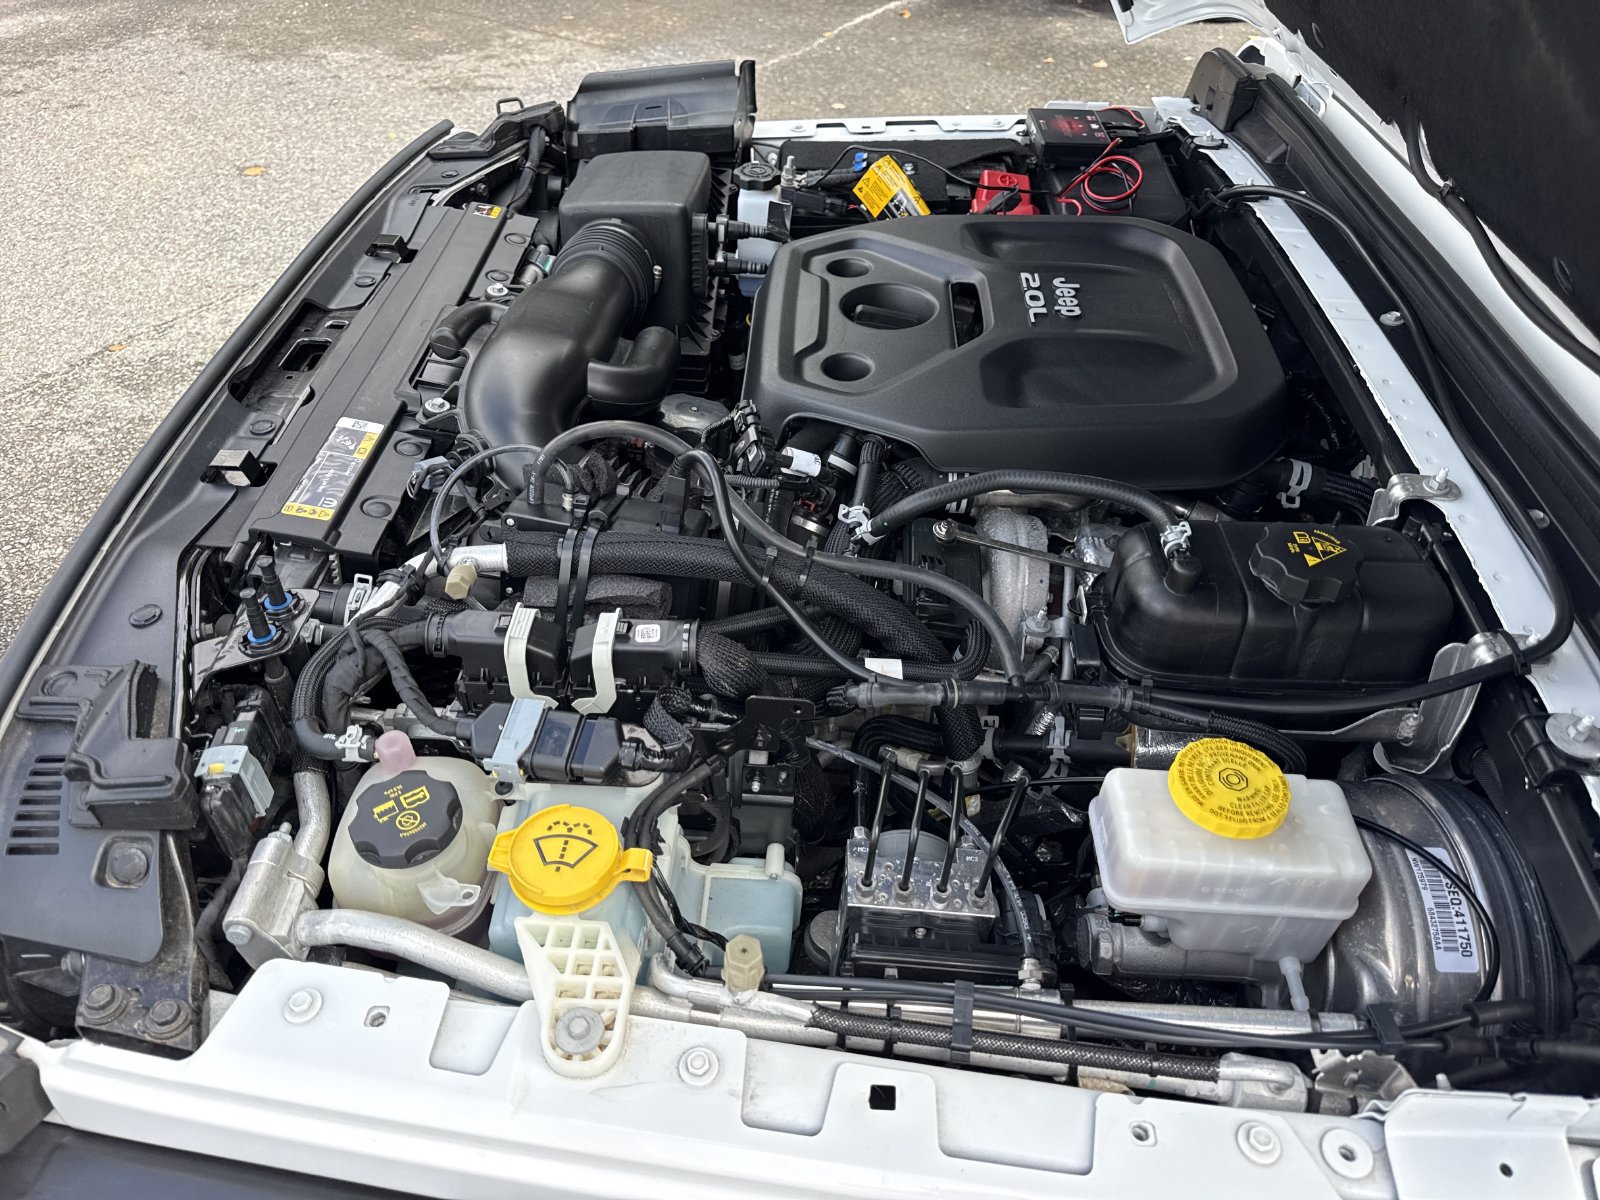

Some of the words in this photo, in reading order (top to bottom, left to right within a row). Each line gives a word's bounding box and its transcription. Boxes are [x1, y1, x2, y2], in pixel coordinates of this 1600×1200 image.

[1020, 272, 1048, 323] 2.0L
[1053, 277, 1082, 316] Jeep
[1208, 807, 1223, 818] DOT
[1228, 815, 1248, 823] FLUID
[1217, 804, 1244, 816] BEFORE
[1229, 801, 1252, 809] CLEAN
[1250, 794, 1268, 808] FILLER
[1427, 907, 1442, 951] 68432758AA
[1445, 882, 1473, 958] SEQ:411750
